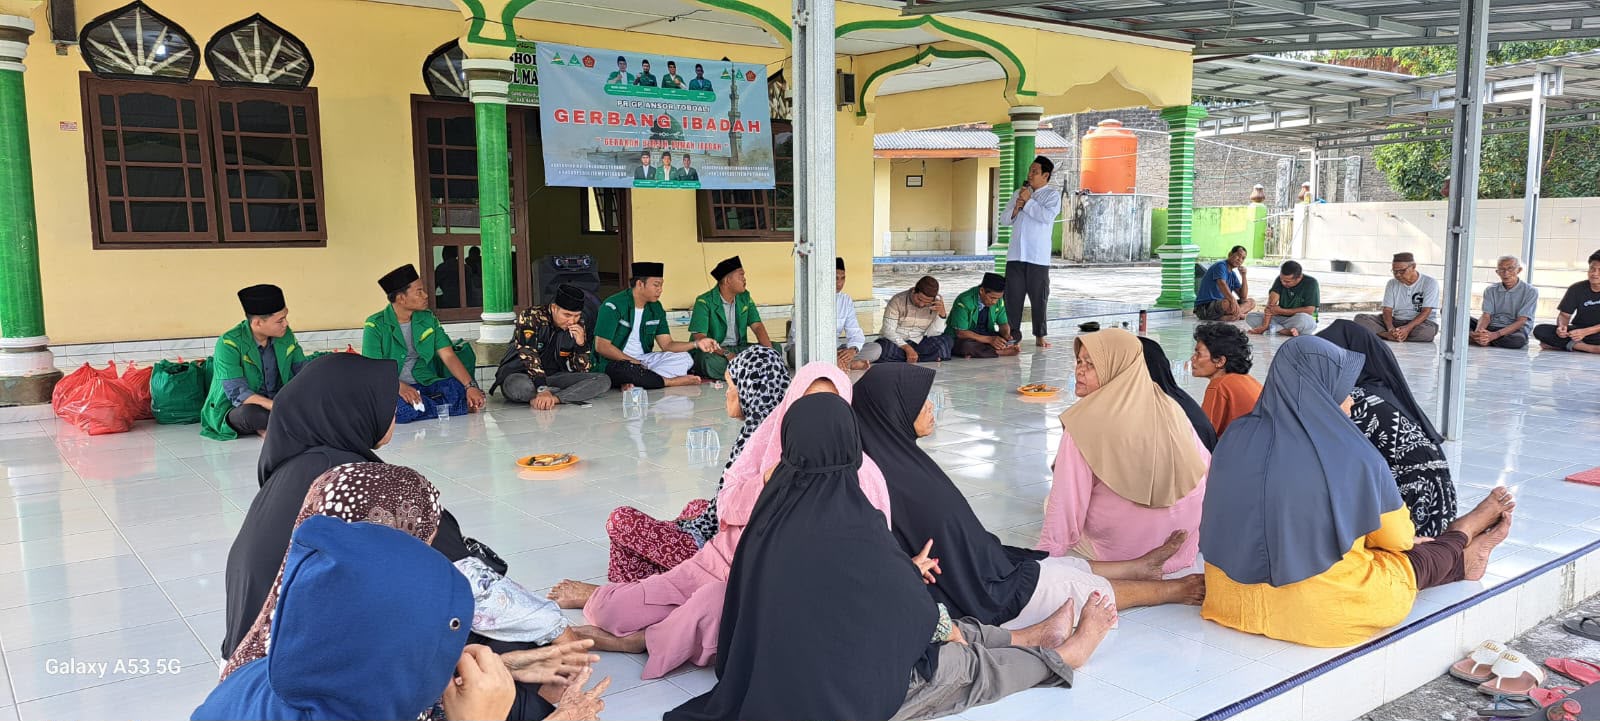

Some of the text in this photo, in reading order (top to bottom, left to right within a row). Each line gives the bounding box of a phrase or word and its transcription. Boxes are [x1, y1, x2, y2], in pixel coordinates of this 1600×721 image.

[645, 102, 675, 110] ANSOR
[676, 103, 711, 112] TOBOALI
[554, 107, 761, 133] GERBANG IBADAH
